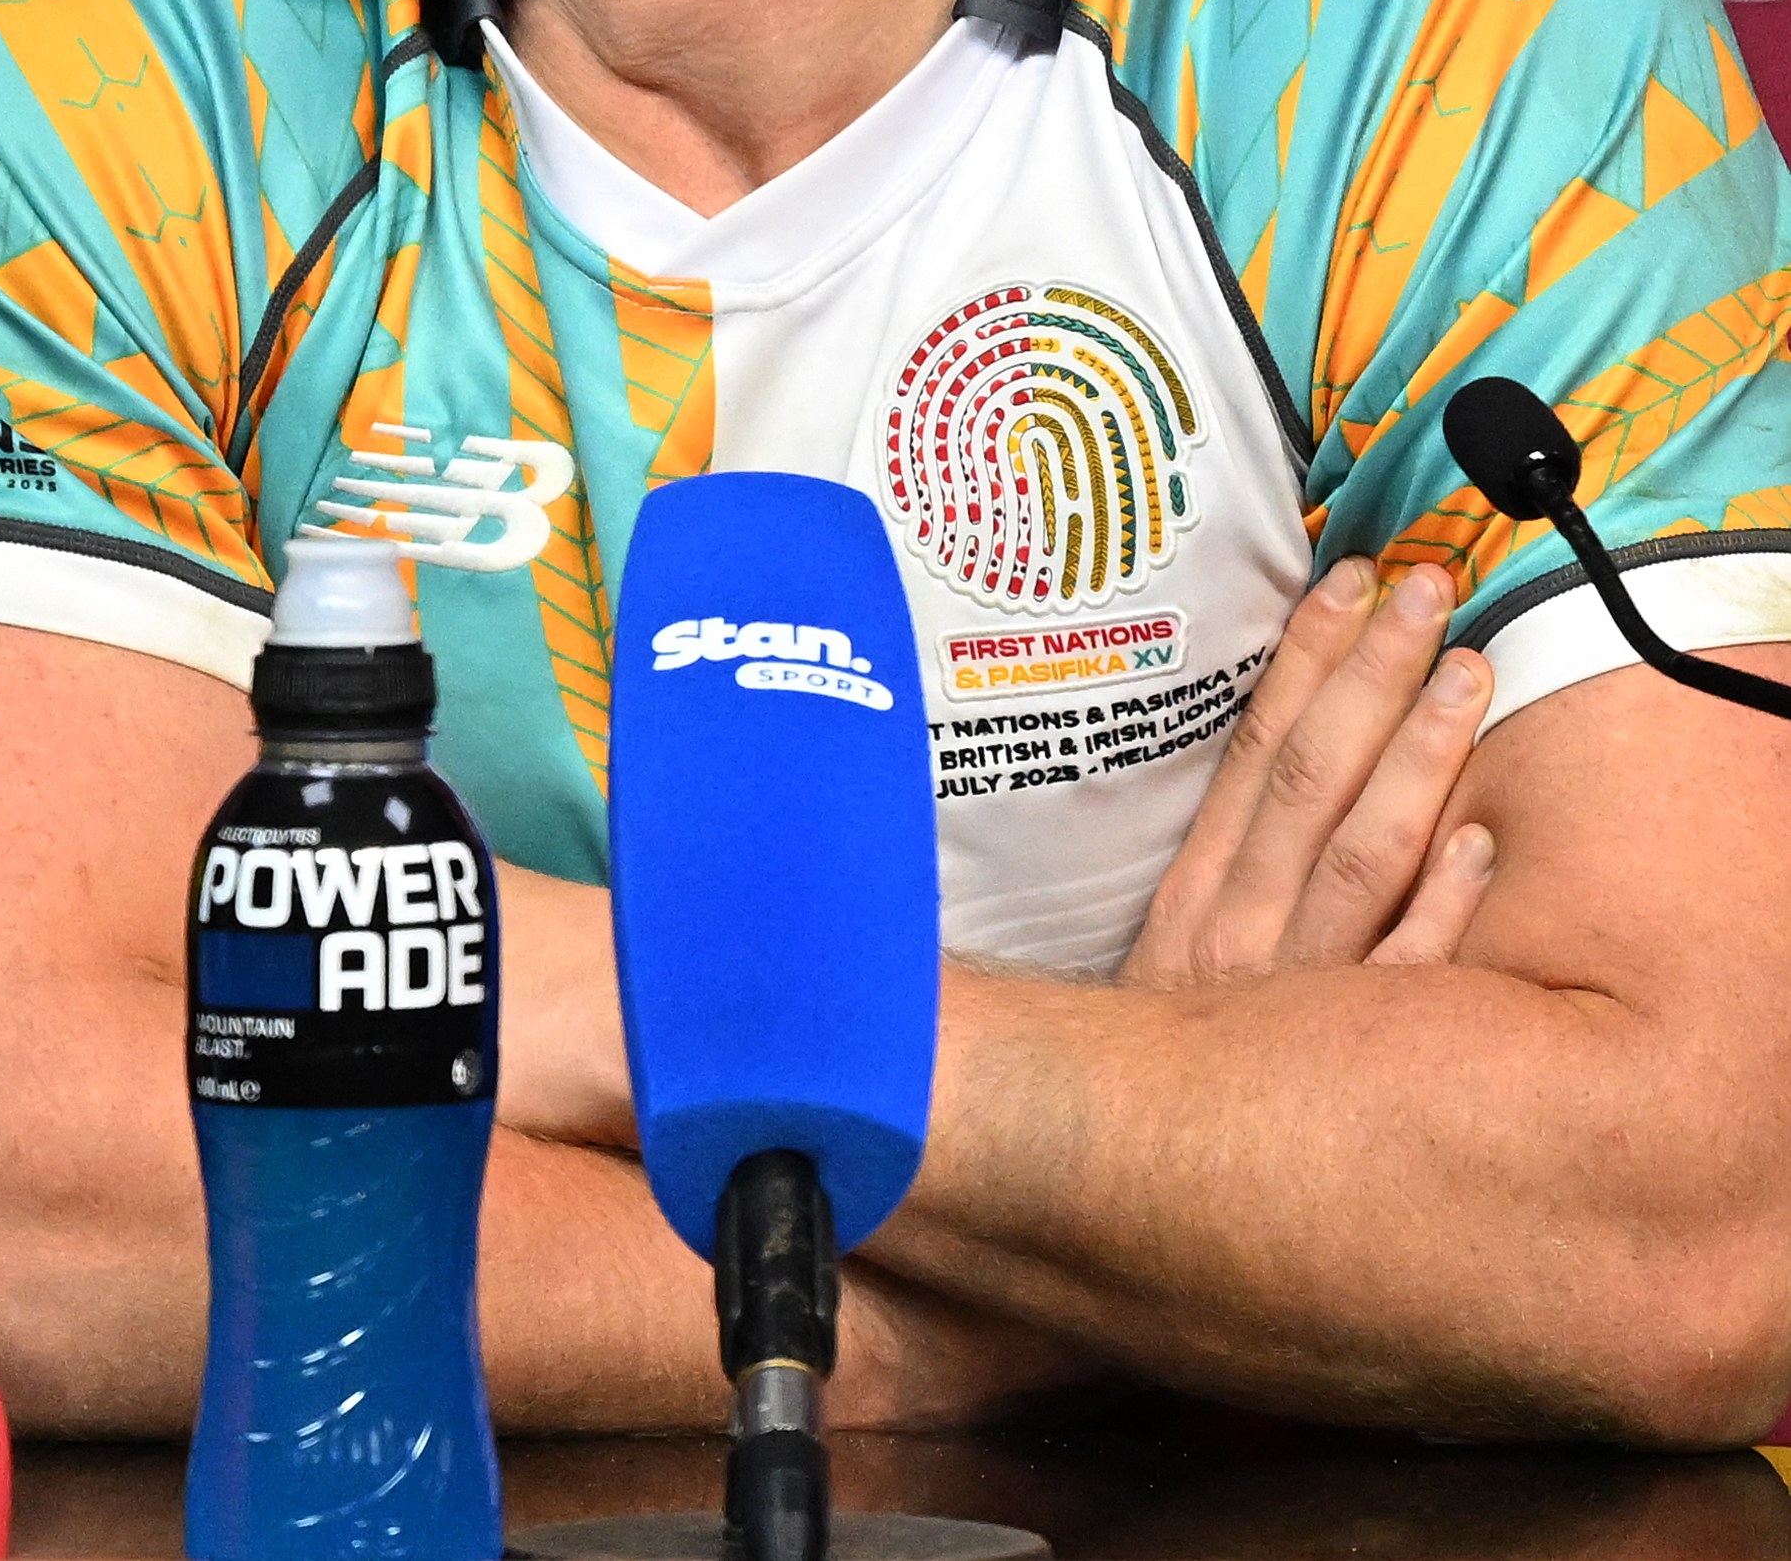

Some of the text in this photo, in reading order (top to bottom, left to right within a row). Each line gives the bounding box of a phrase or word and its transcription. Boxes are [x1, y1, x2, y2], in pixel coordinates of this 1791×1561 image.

[949, 620, 1173, 662] FIRST NATIONS
[955, 645, 1173, 690] & PASIFIKA XV
[759, 669, 873, 699] SPORT
[954, 710, 1079, 739] NATIONS
[1086, 706, 1105, 724] &
[1111, 669, 1229, 721] PASIFIKA
[1236, 646, 1267, 678] XV
[939, 686, 1236, 771] BRITISH & IRISH LIONS
[936, 773, 1002, 800] JULY
[1009, 764, 1080, 791] 2025
[198, 841, 483, 928] POWER
[319, 923, 485, 1012] ADE
